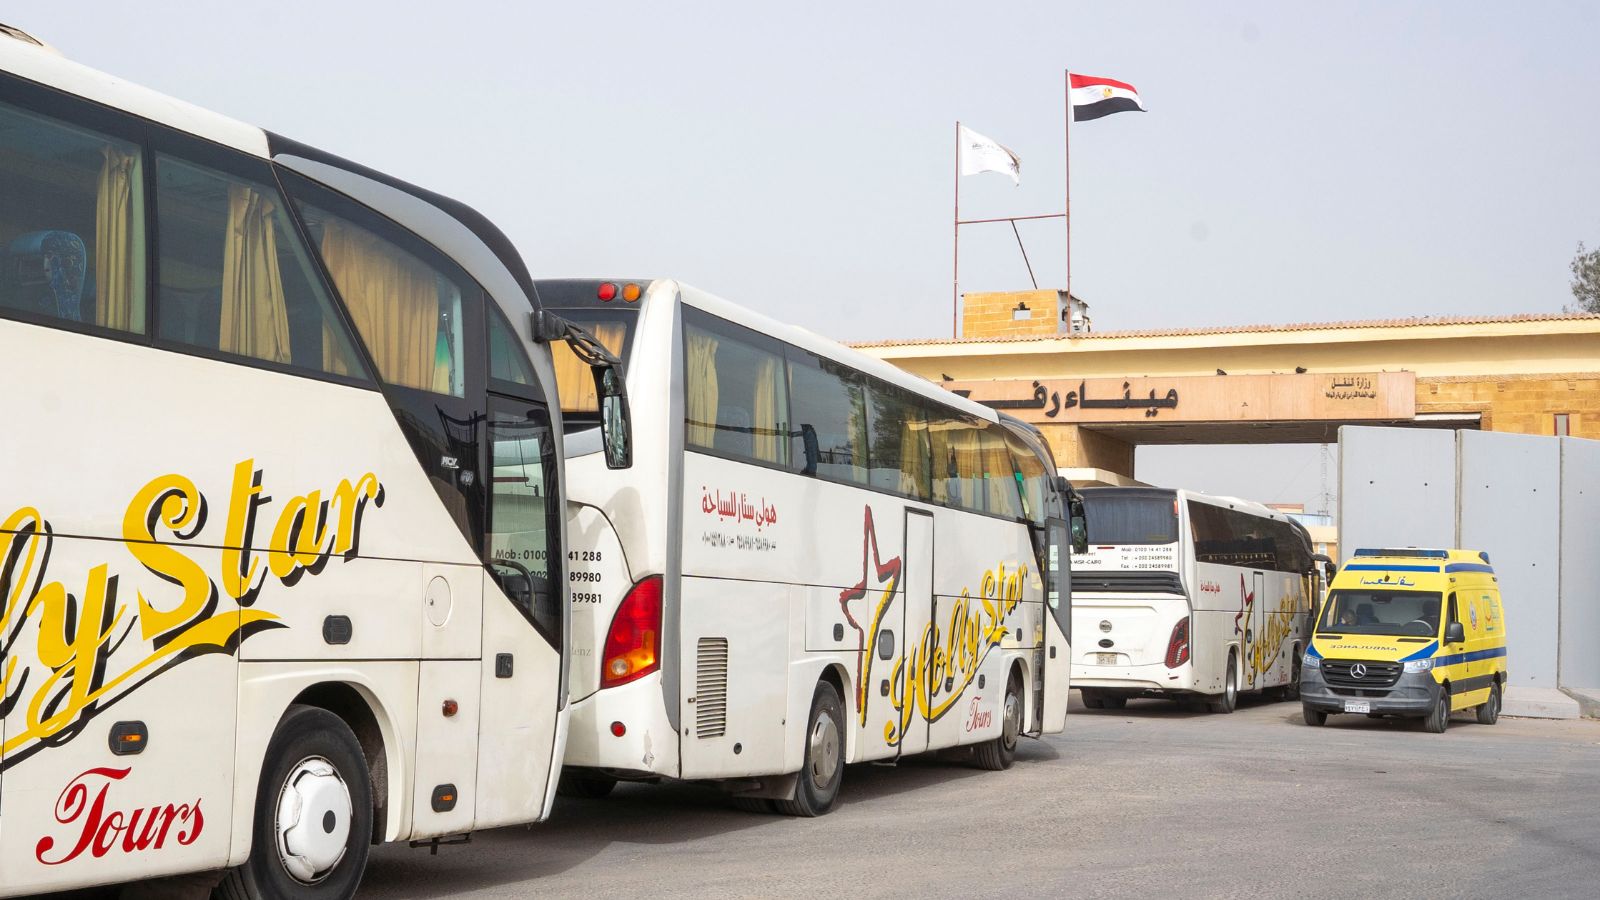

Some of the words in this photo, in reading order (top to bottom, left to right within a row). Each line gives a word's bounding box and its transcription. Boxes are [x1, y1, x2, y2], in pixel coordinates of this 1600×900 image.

[1065, 379, 1178, 417] ميناء
[702, 486, 736, 521] للسياحة
[738, 493, 754, 523] ستار
[756, 497, 777, 532] هولي
[122, 458, 384, 649] Star
[523, 549, 547, 560] 0100
[568, 551, 579, 561] 41
[582, 551, 602, 562] 288
[571, 646, 592, 657] enz
[884, 586, 981, 747] Holly
[980, 561, 1028, 632] Star
[966, 696, 993, 733] Tours
[36, 767, 204, 866] Tours
